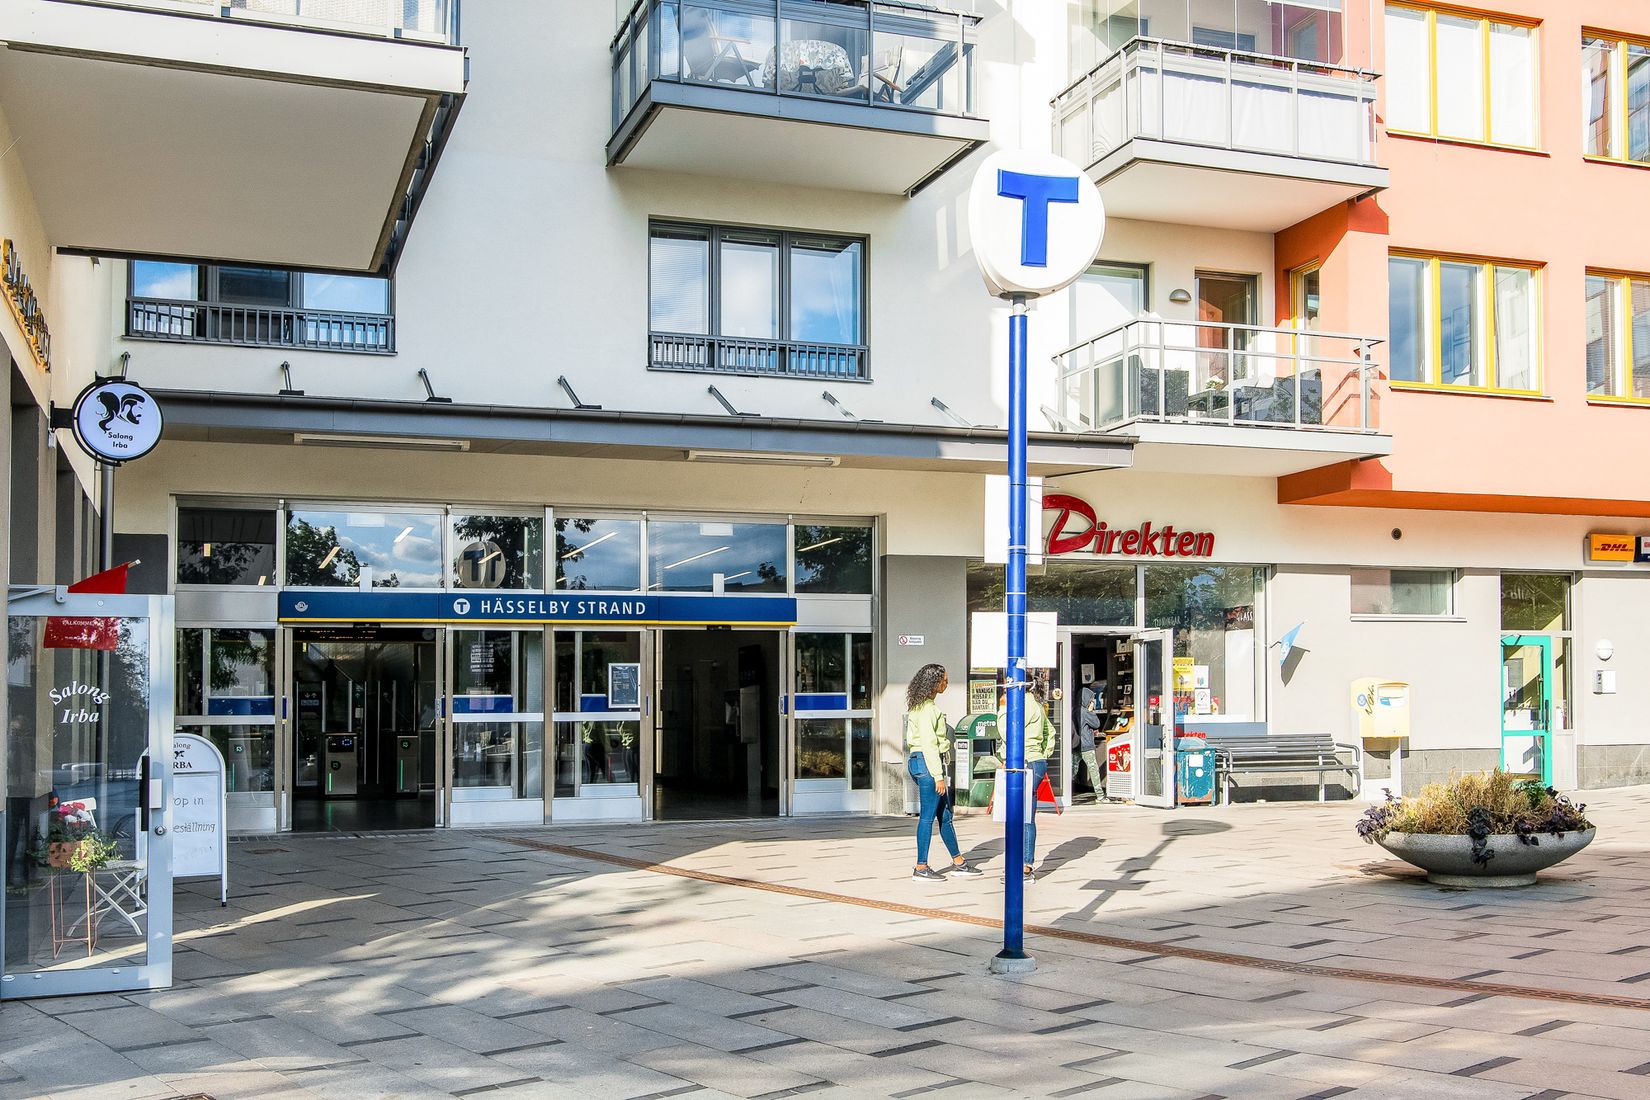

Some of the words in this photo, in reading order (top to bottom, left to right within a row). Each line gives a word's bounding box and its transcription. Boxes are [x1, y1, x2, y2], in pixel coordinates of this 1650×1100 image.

[997, 168, 1079, 268] T
[108, 432, 133, 441] Salong
[112, 441, 128, 449] Irba
[1042, 494, 1215, 557] Direkten
[1600, 543, 1628, 552] DHL
[481, 597, 570, 615] HÄSSELBY
[577, 601, 646, 615] STRAND
[49, 680, 110, 706] Salong
[60, 708, 100, 724] Irba
[173, 742, 191, 750] along
[173, 761, 193, 769] RBA
[173, 797, 189, 808] op
[193, 796, 204, 806] in
[173, 821, 216, 833] eställning
